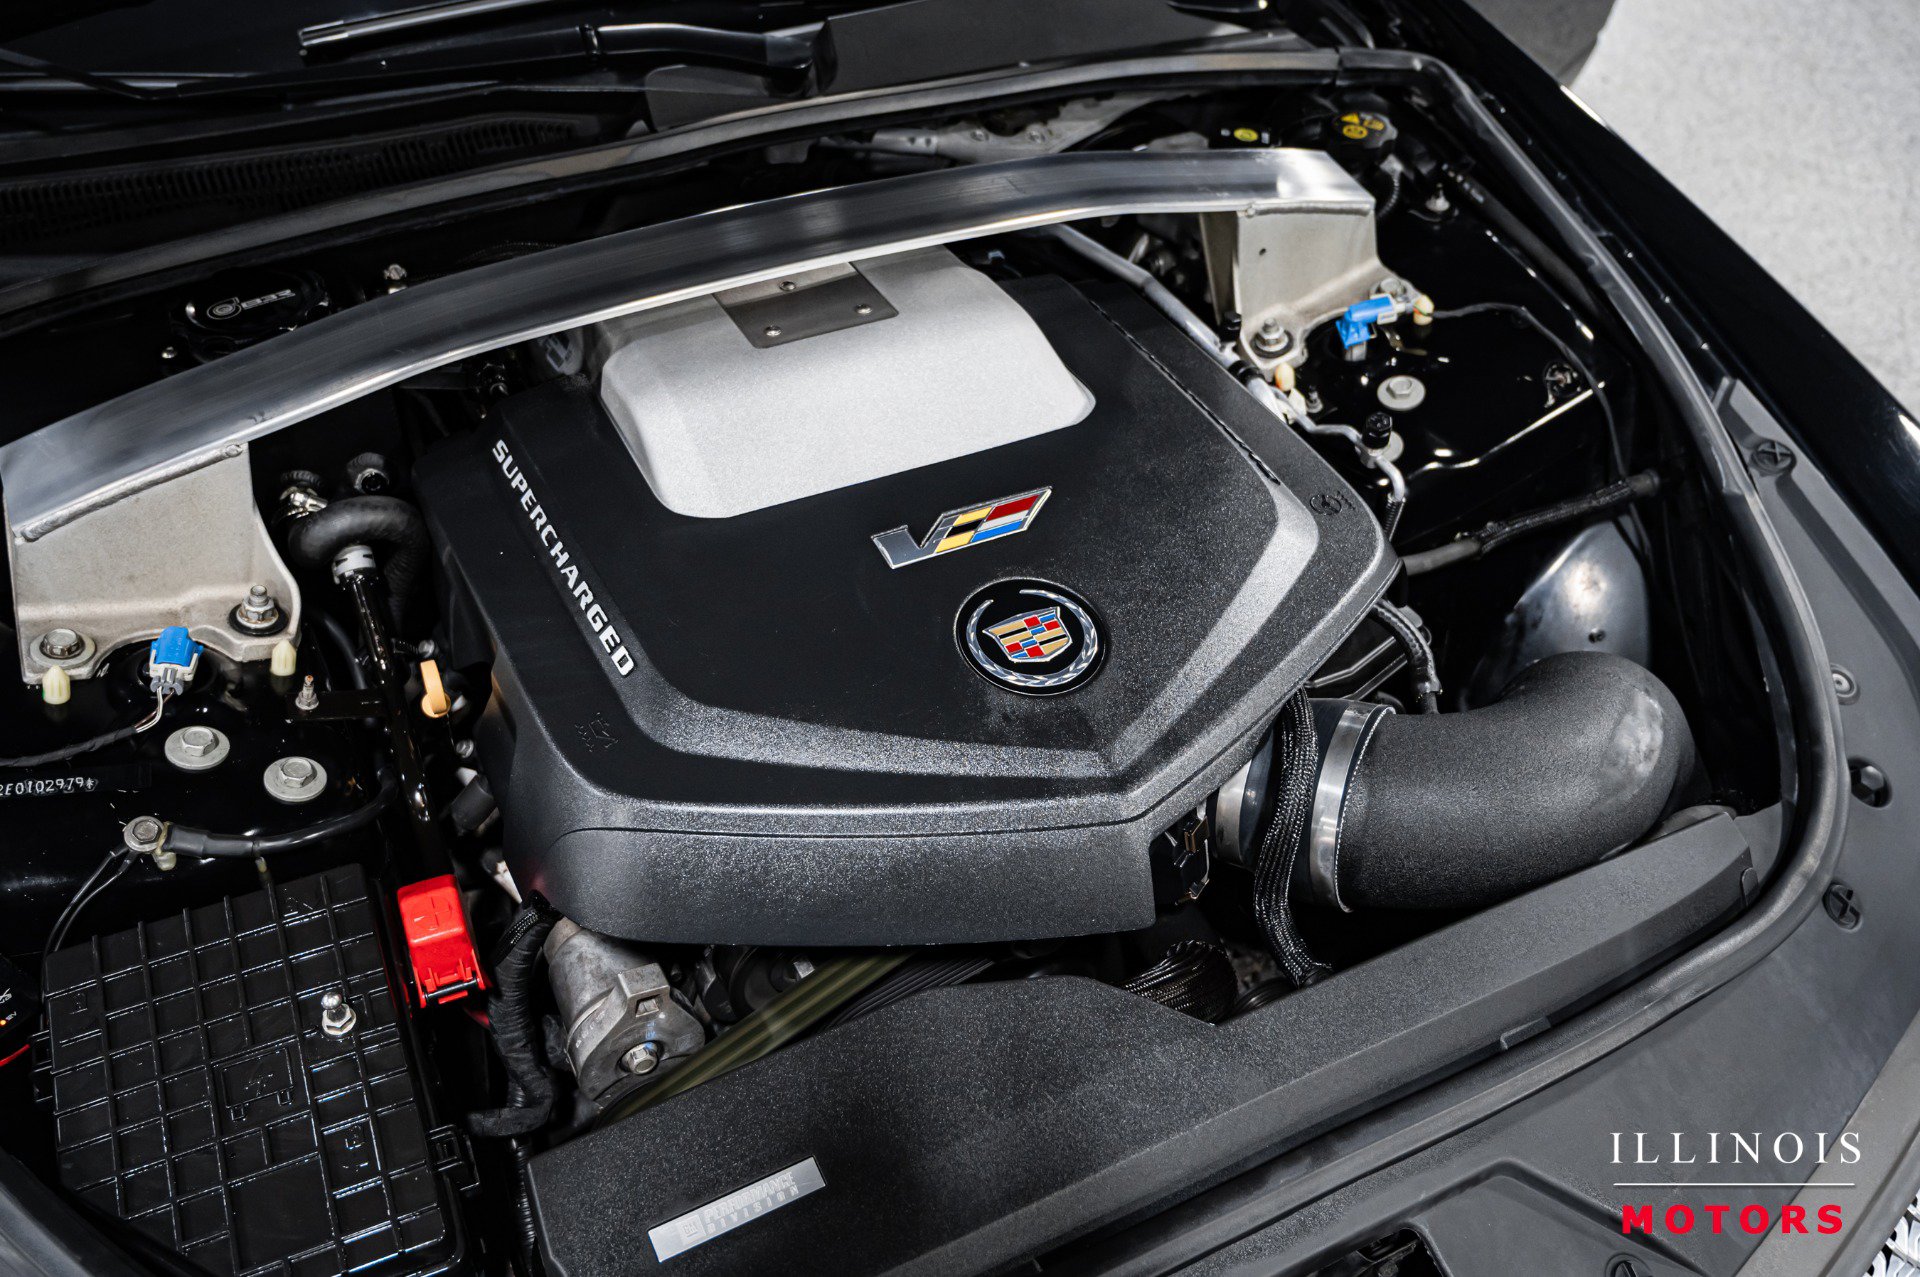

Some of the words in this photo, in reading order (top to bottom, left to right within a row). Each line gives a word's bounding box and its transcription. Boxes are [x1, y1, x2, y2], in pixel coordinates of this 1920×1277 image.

[493, 439, 635, 676] SUPERCHARGED
[704, 1171, 796, 1223] PERFORMANCE
[706, 1184, 799, 1234] DIVISION
